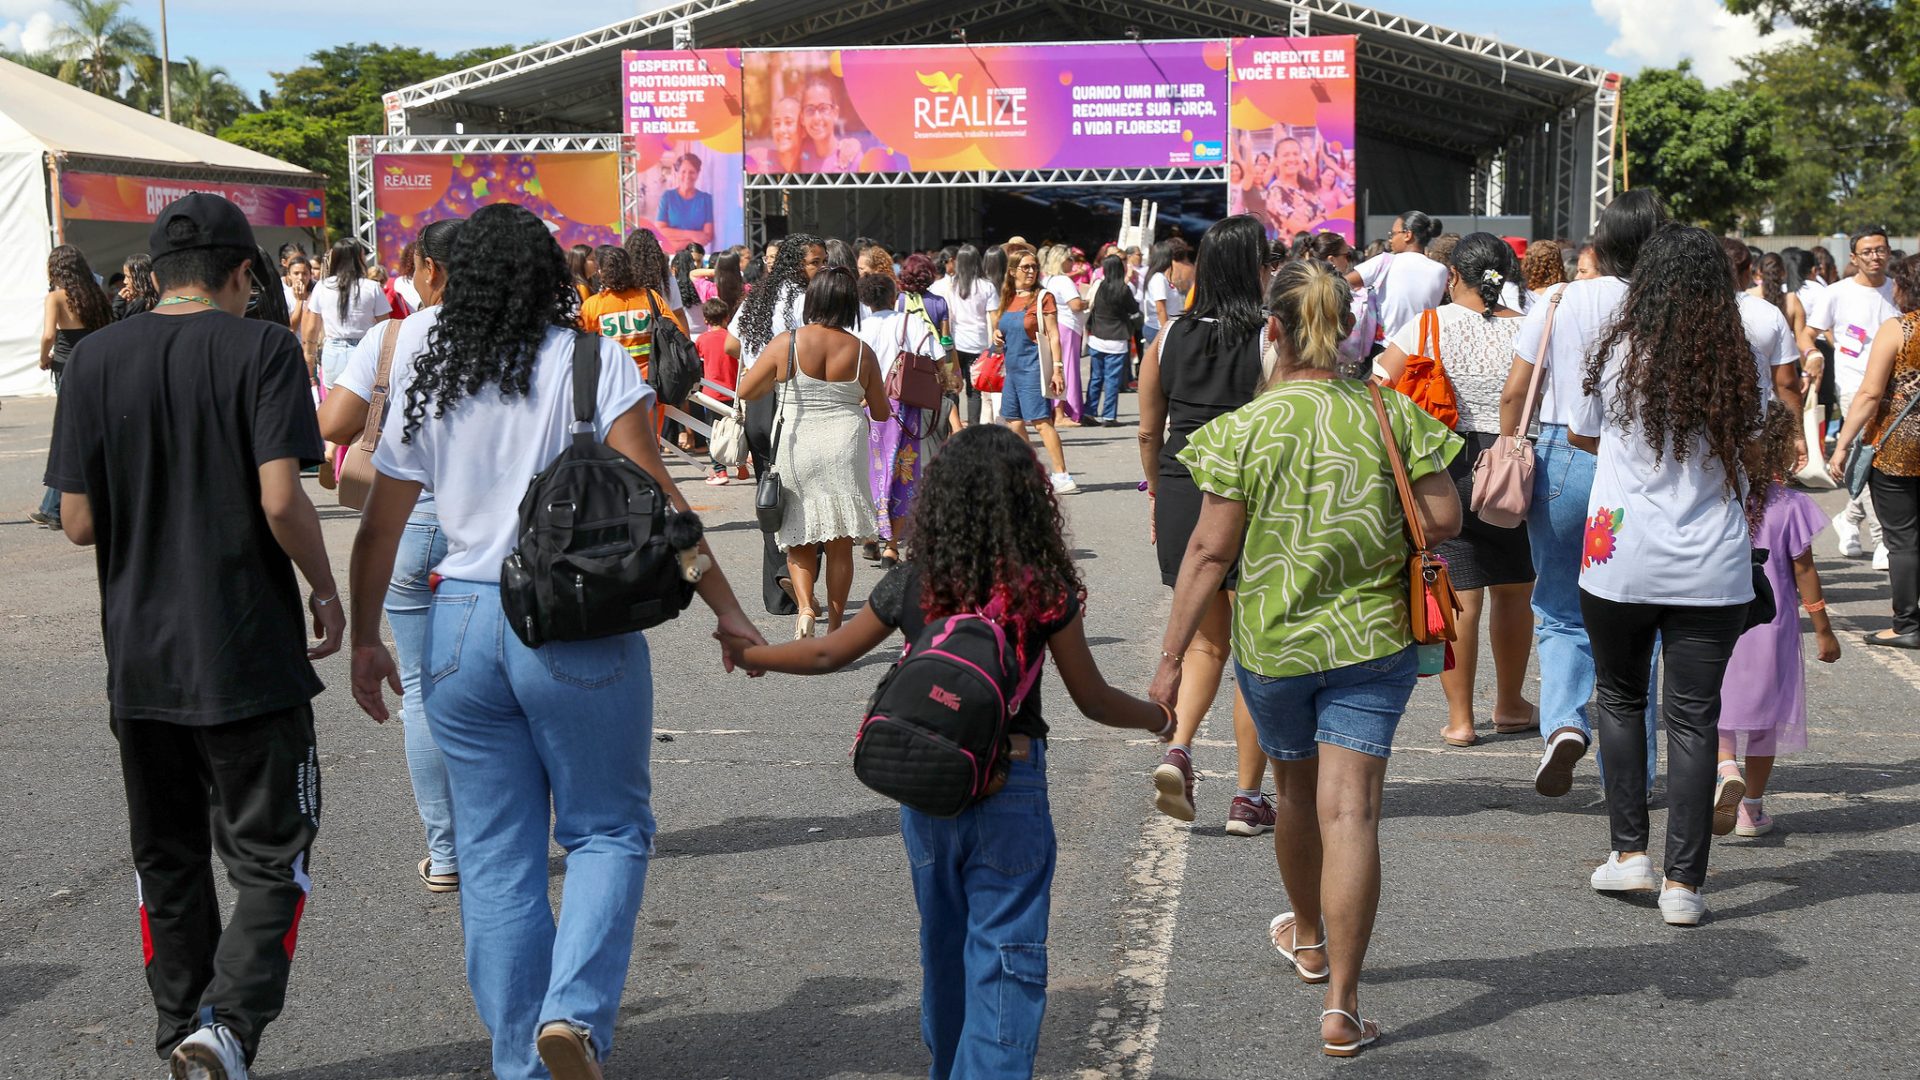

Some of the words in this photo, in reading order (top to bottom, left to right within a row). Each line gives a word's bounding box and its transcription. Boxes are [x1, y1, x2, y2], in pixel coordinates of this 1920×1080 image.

[1253, 50, 1320, 64] ACREDITE
[1323, 50, 1345, 62] EM
[629, 60, 695, 72] DESPERTE
[698, 59, 707, 72] A
[1237, 64, 1273, 80] VOCÊ
[1276, 67, 1286, 79] E
[1289, 66, 1350, 79] REALIZE.
[629, 74, 725, 87] PROTAGONISTA
[629, 91, 655, 103] QUE
[658, 90, 704, 102] EXISTE
[1072, 86, 1121, 100] QUANDO
[1124, 85, 1151, 99] UMA
[1155, 84, 1205, 98] MULHER
[630, 106, 650, 118] EM
[653, 103, 687, 118] VOCÊ
[914, 95, 1027, 128] REALIZE
[1072, 102, 1144, 117] RECONHECE
[1147, 102, 1171, 116] SUA
[1174, 101, 1217, 117] FORÇA,
[630, 122, 639, 133] E
[642, 121, 699, 133] REALIZE.
[1072, 121, 1081, 135] A
[1084, 121, 1112, 135] VIDA
[1115, 120, 1181, 134] FLORESCE!
[384, 175, 432, 187] REALIZE
[602, 313, 651, 337] SLU
